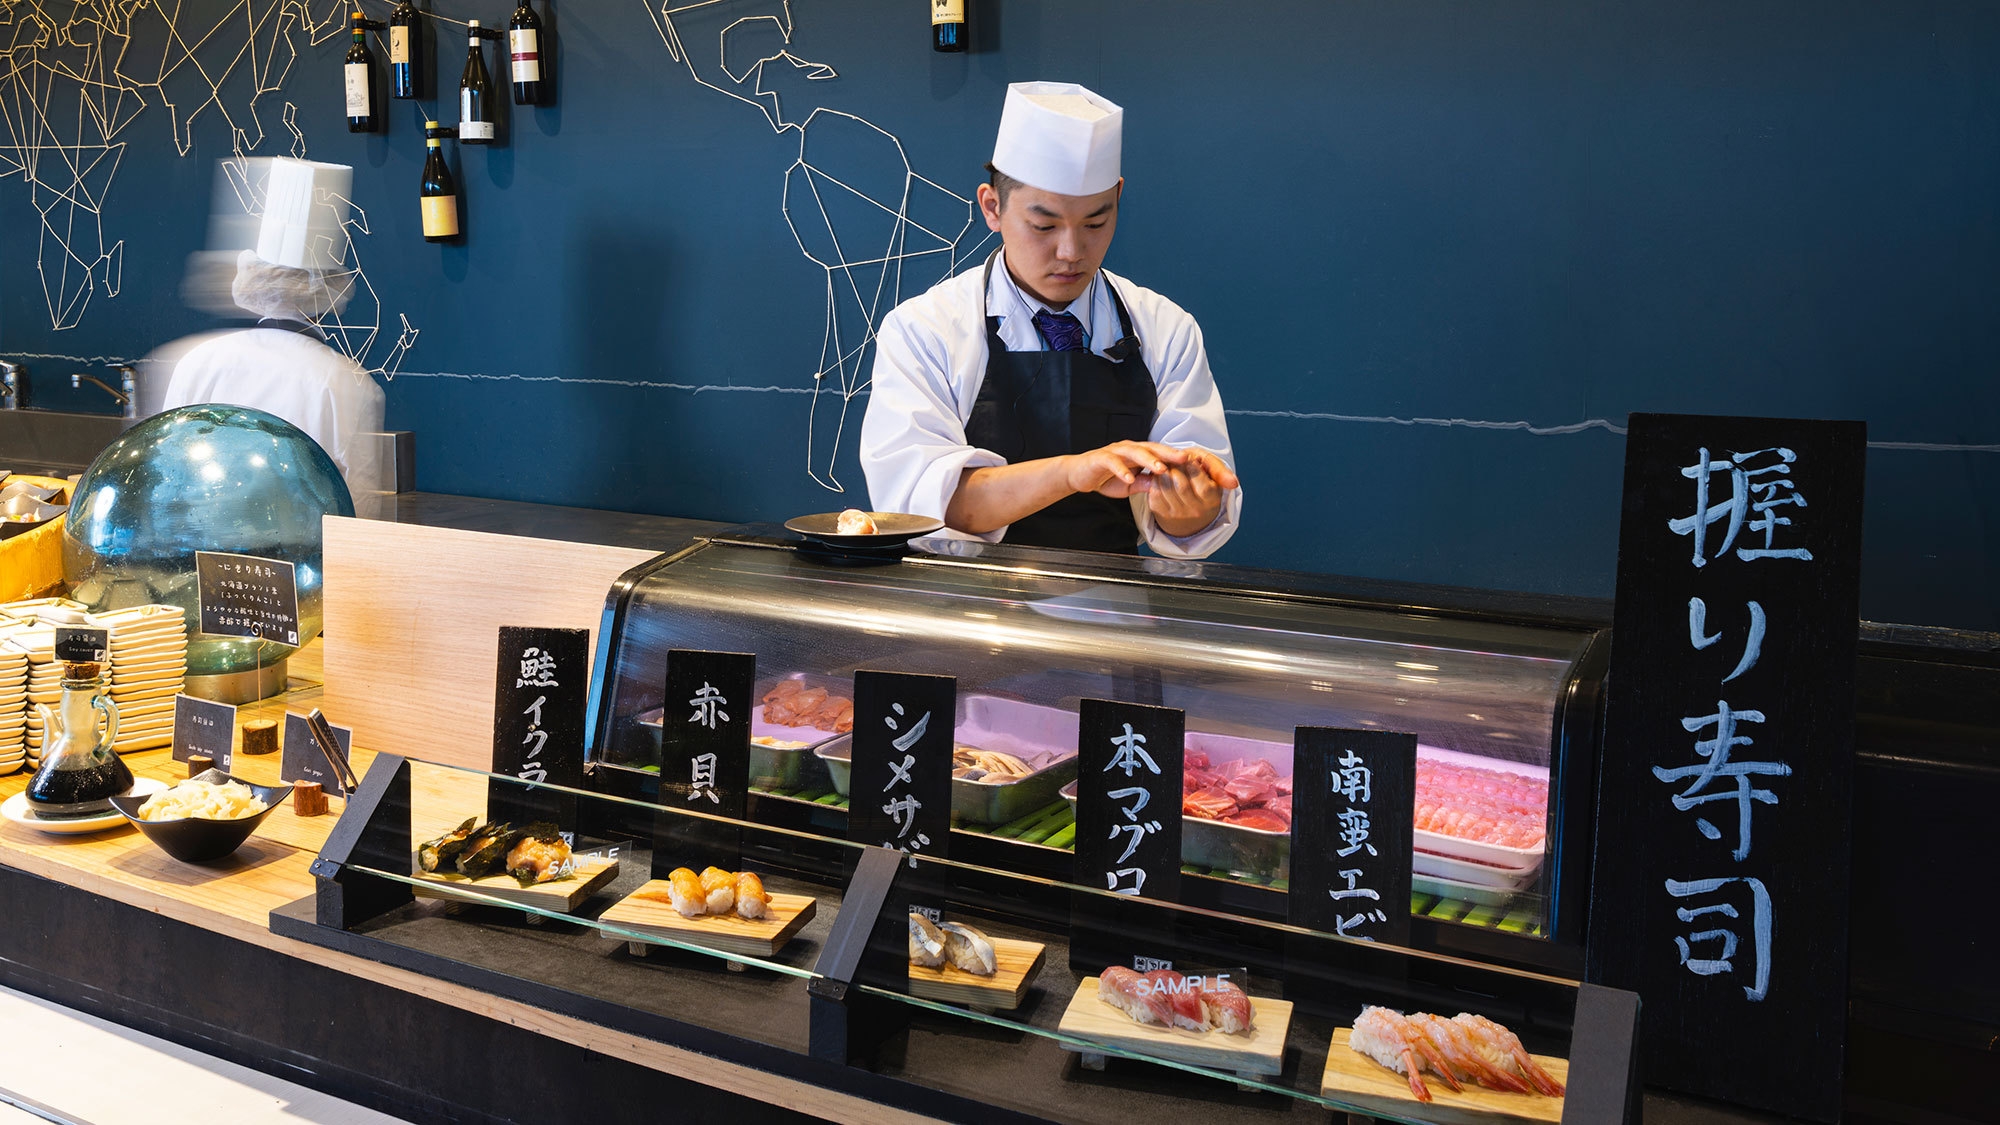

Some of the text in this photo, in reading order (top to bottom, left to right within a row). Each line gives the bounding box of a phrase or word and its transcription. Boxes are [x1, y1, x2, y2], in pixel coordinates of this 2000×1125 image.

[515, 647, 559, 791] 鮭イクラ
[687, 681, 730, 804] 赤貝
[1652, 447, 1814, 1000] 握り寿司
[548, 847, 620, 875] SAMPLE
[1103, 722, 1163, 896] 本マグロ
[1329, 749, 1387, 942] 南蛮エビ
[1136, 974, 1231, 997] SAMPLE
